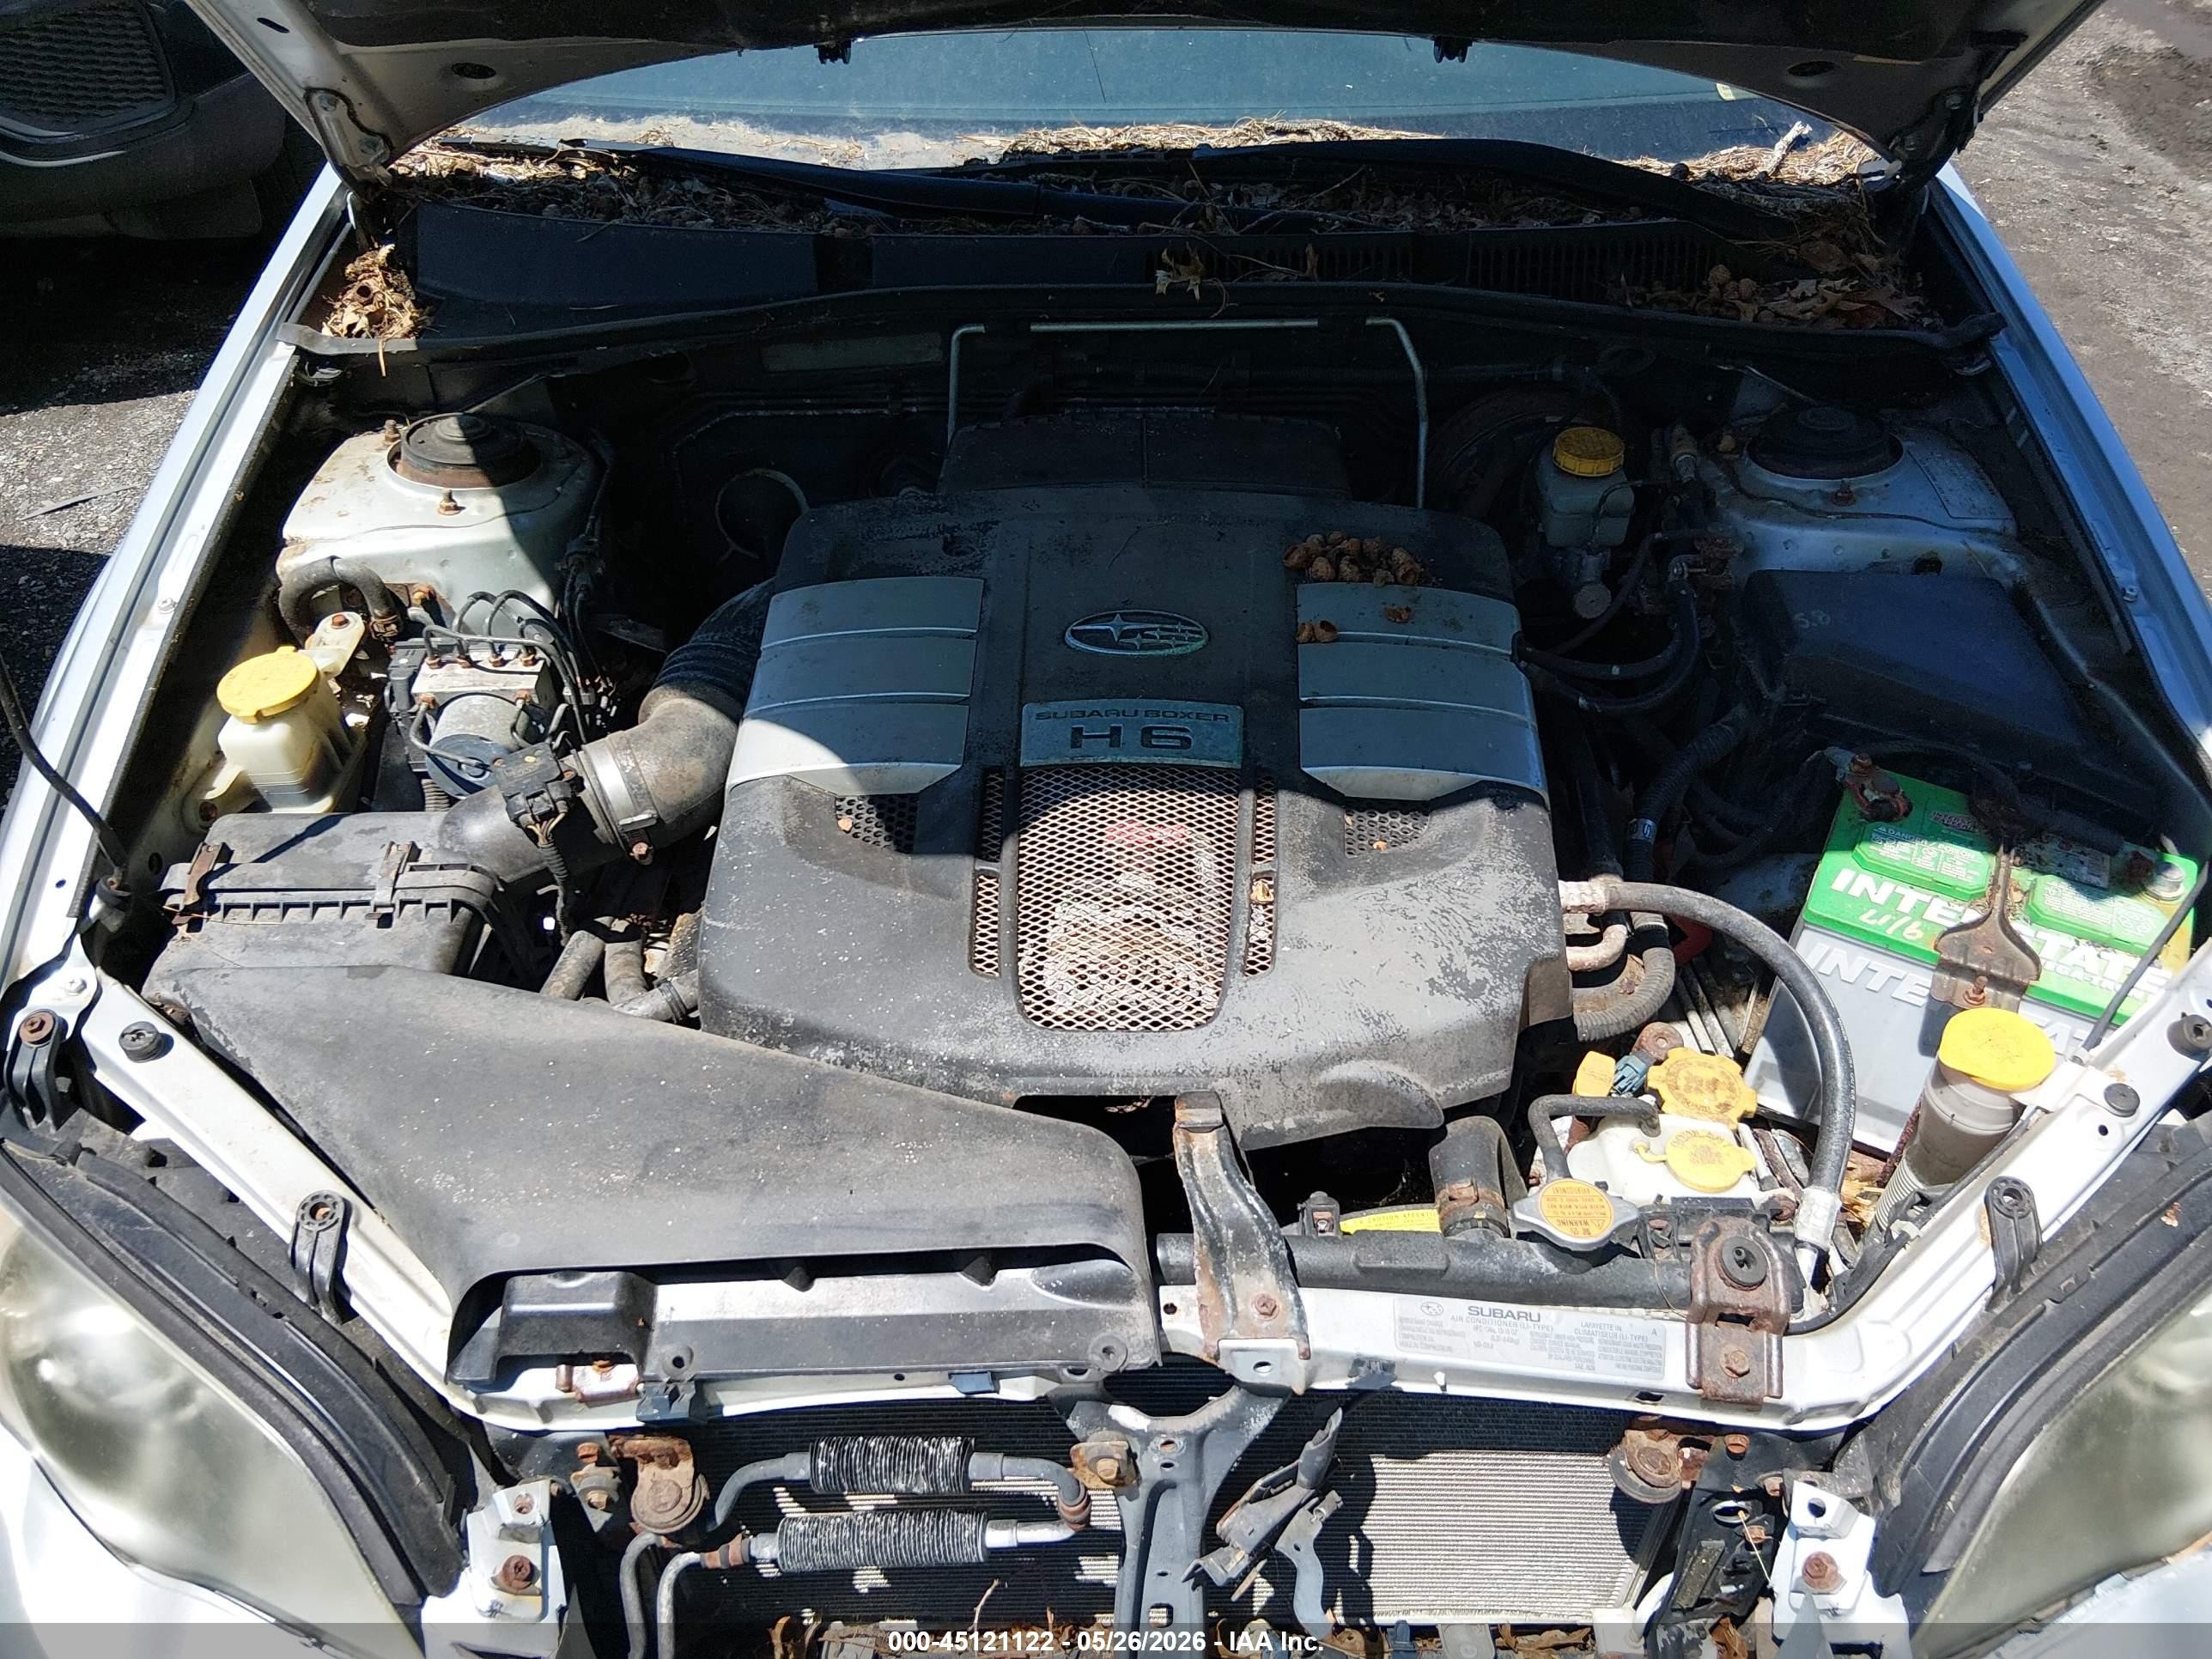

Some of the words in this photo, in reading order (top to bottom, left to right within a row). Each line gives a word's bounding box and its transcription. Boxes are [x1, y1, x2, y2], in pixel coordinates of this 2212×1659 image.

[1036, 708, 1139, 720] SUBARU
[1144, 709, 1230, 722] BOXER
[1887, 828, 1928, 845] DANGER
[1555, 1218, 1590, 1227] WARNING
[1468, 1305, 1541, 1322] SUBARU
[1450, 1315, 1463, 1323] AIR
[1466, 1316, 1518, 1328] CONDITIONER
